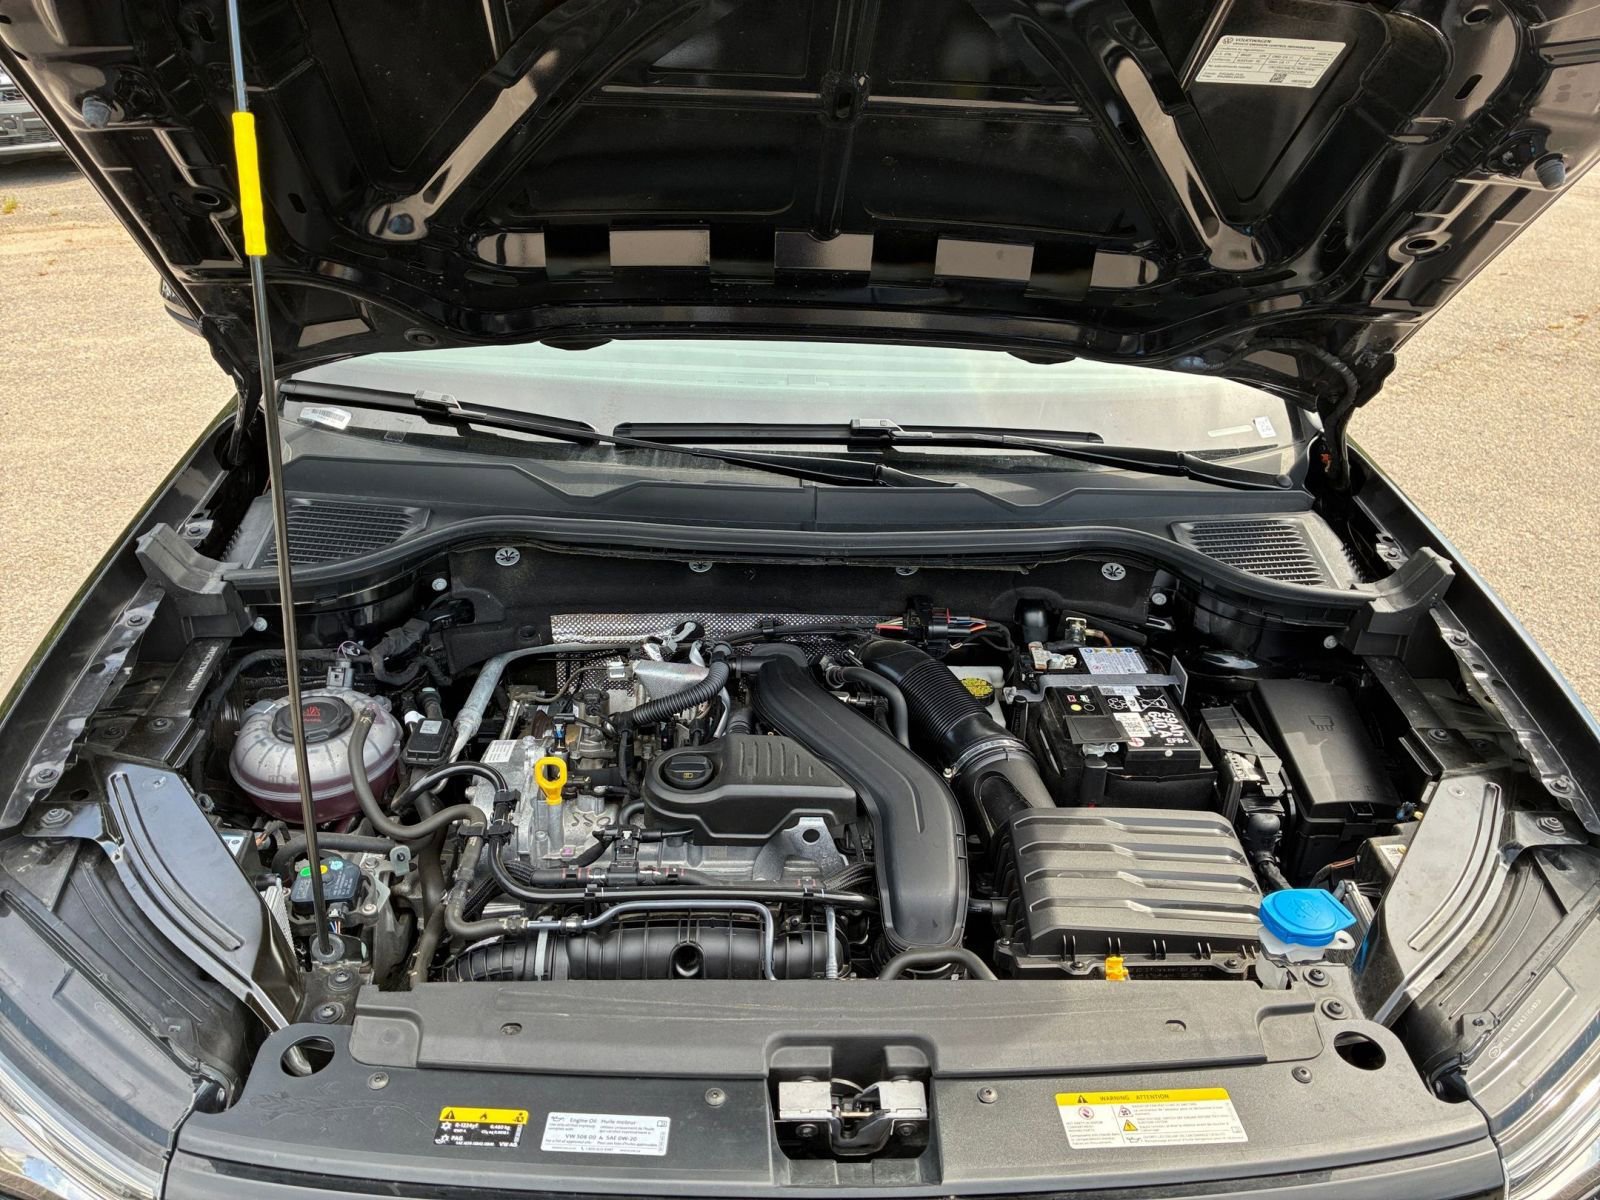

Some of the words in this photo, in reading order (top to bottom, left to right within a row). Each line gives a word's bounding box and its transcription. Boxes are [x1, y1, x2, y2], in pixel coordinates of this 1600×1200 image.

[1148, 711, 1168, 729] 640
[1161, 711, 1186, 737] 59Ah
[1136, 1093, 1170, 1101] ATTENTION
